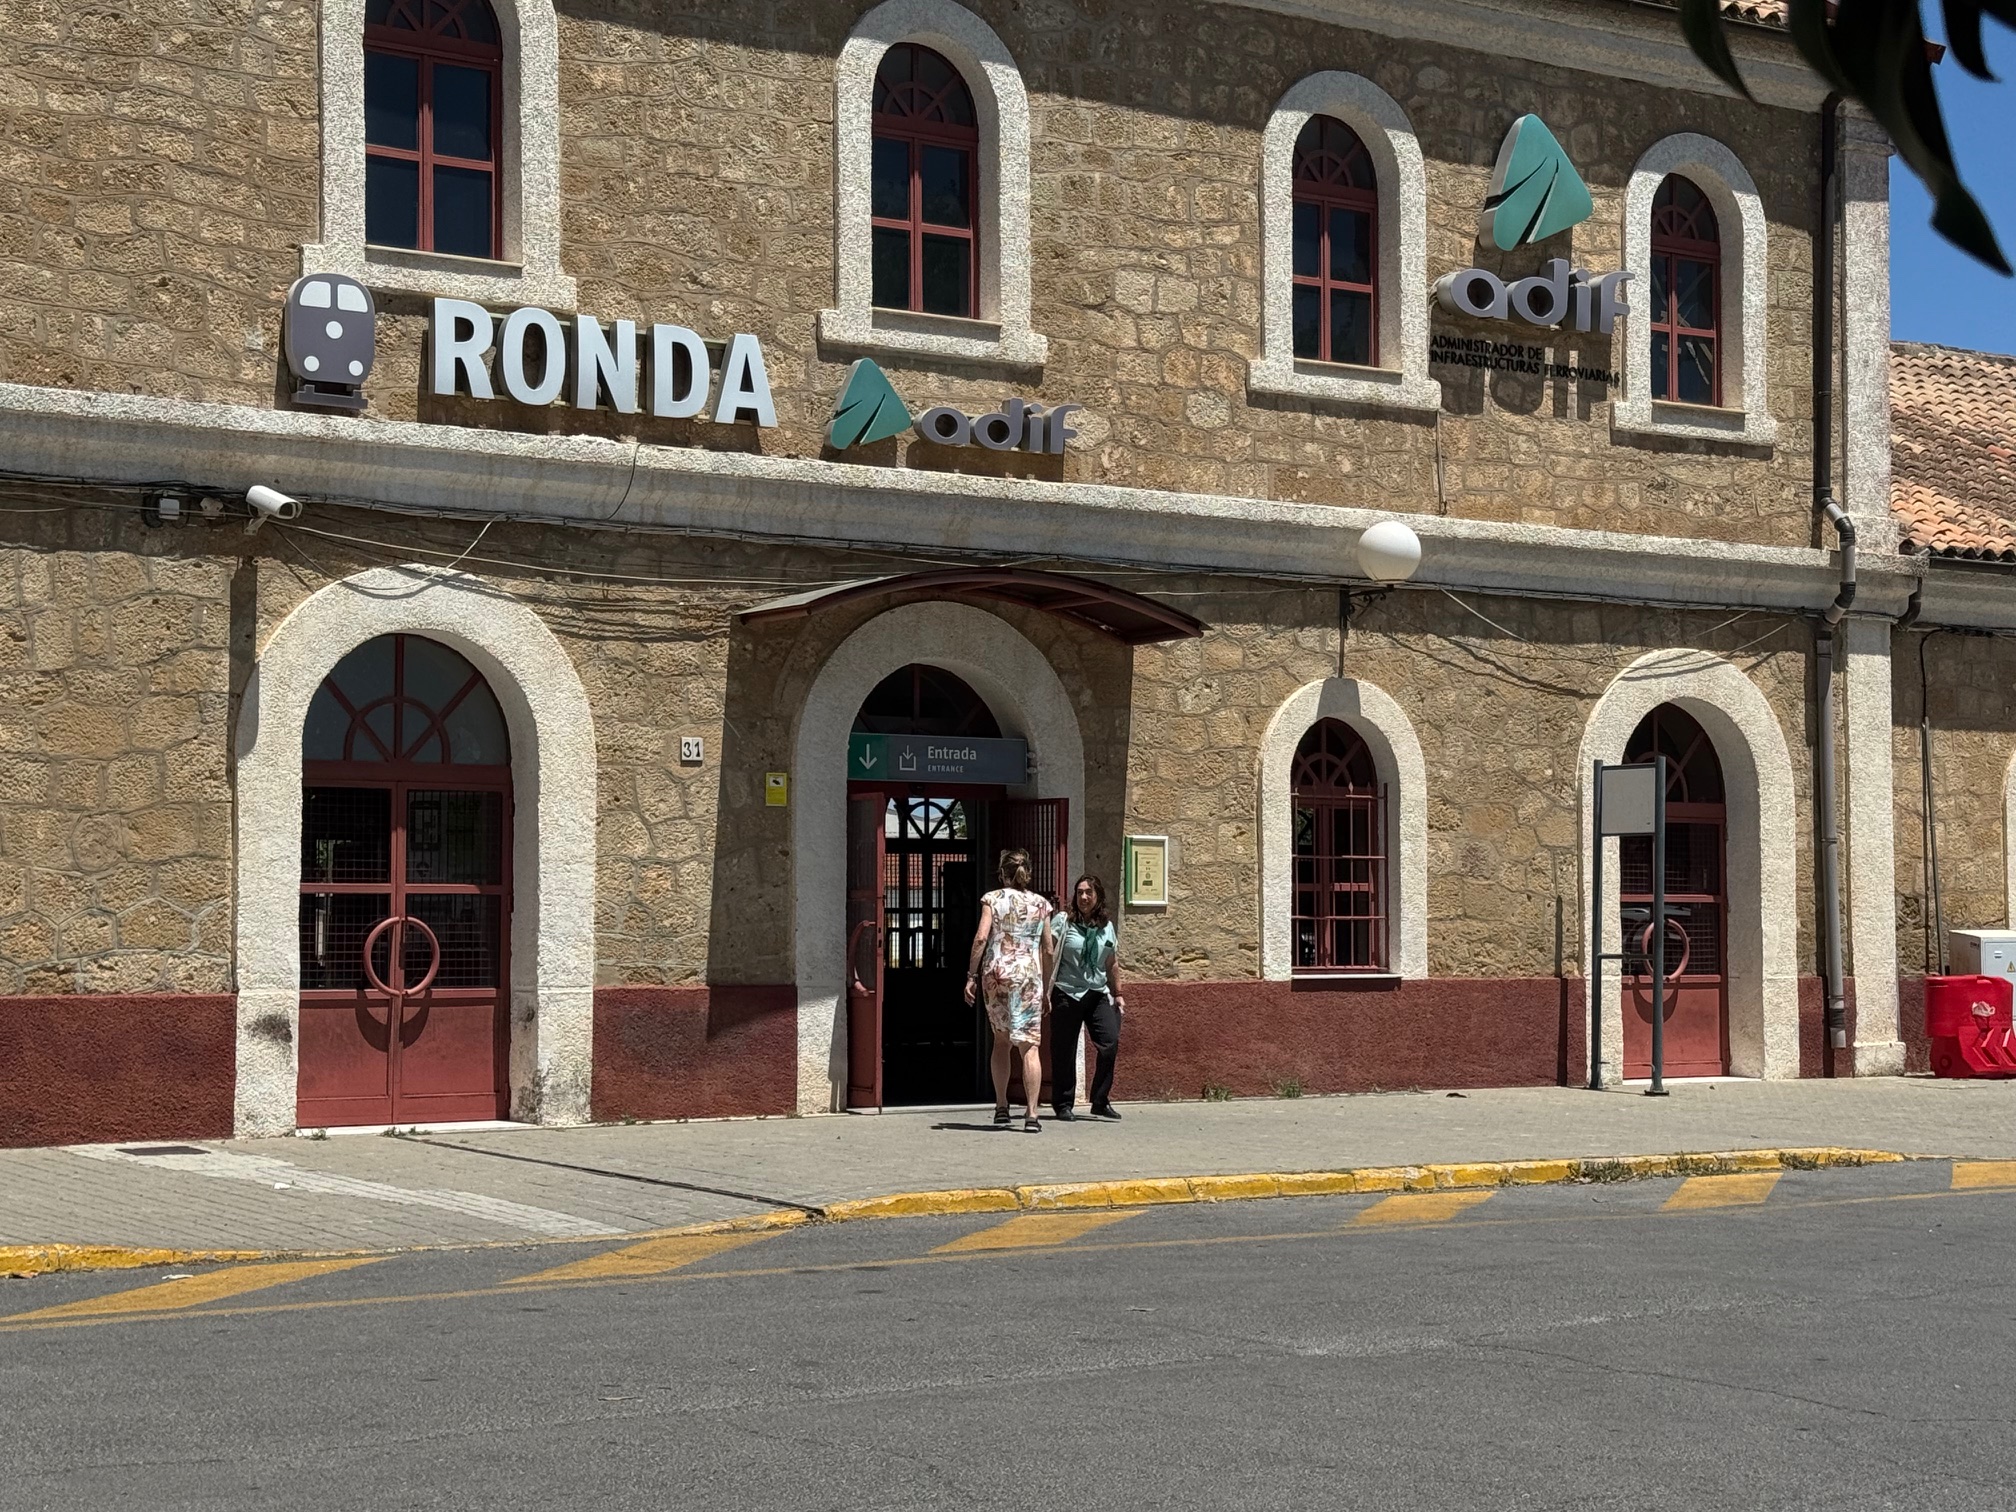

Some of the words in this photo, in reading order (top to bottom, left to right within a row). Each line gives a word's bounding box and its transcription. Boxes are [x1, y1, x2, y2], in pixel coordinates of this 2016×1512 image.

[1440, 257, 1636, 335] adif
[1431, 335, 1525, 359] ADMINISTRADOR
[1527, 346, 1543, 361] DE
[431, 297, 778, 428] RONDA
[1431, 349, 1541, 375] INFRAESTRUCTURAS
[916, 396, 1083, 455] adif
[683, 741, 701, 758] 31
[927, 745, 977, 760] Entrada
[927, 764, 964, 773] ENTRANCE
